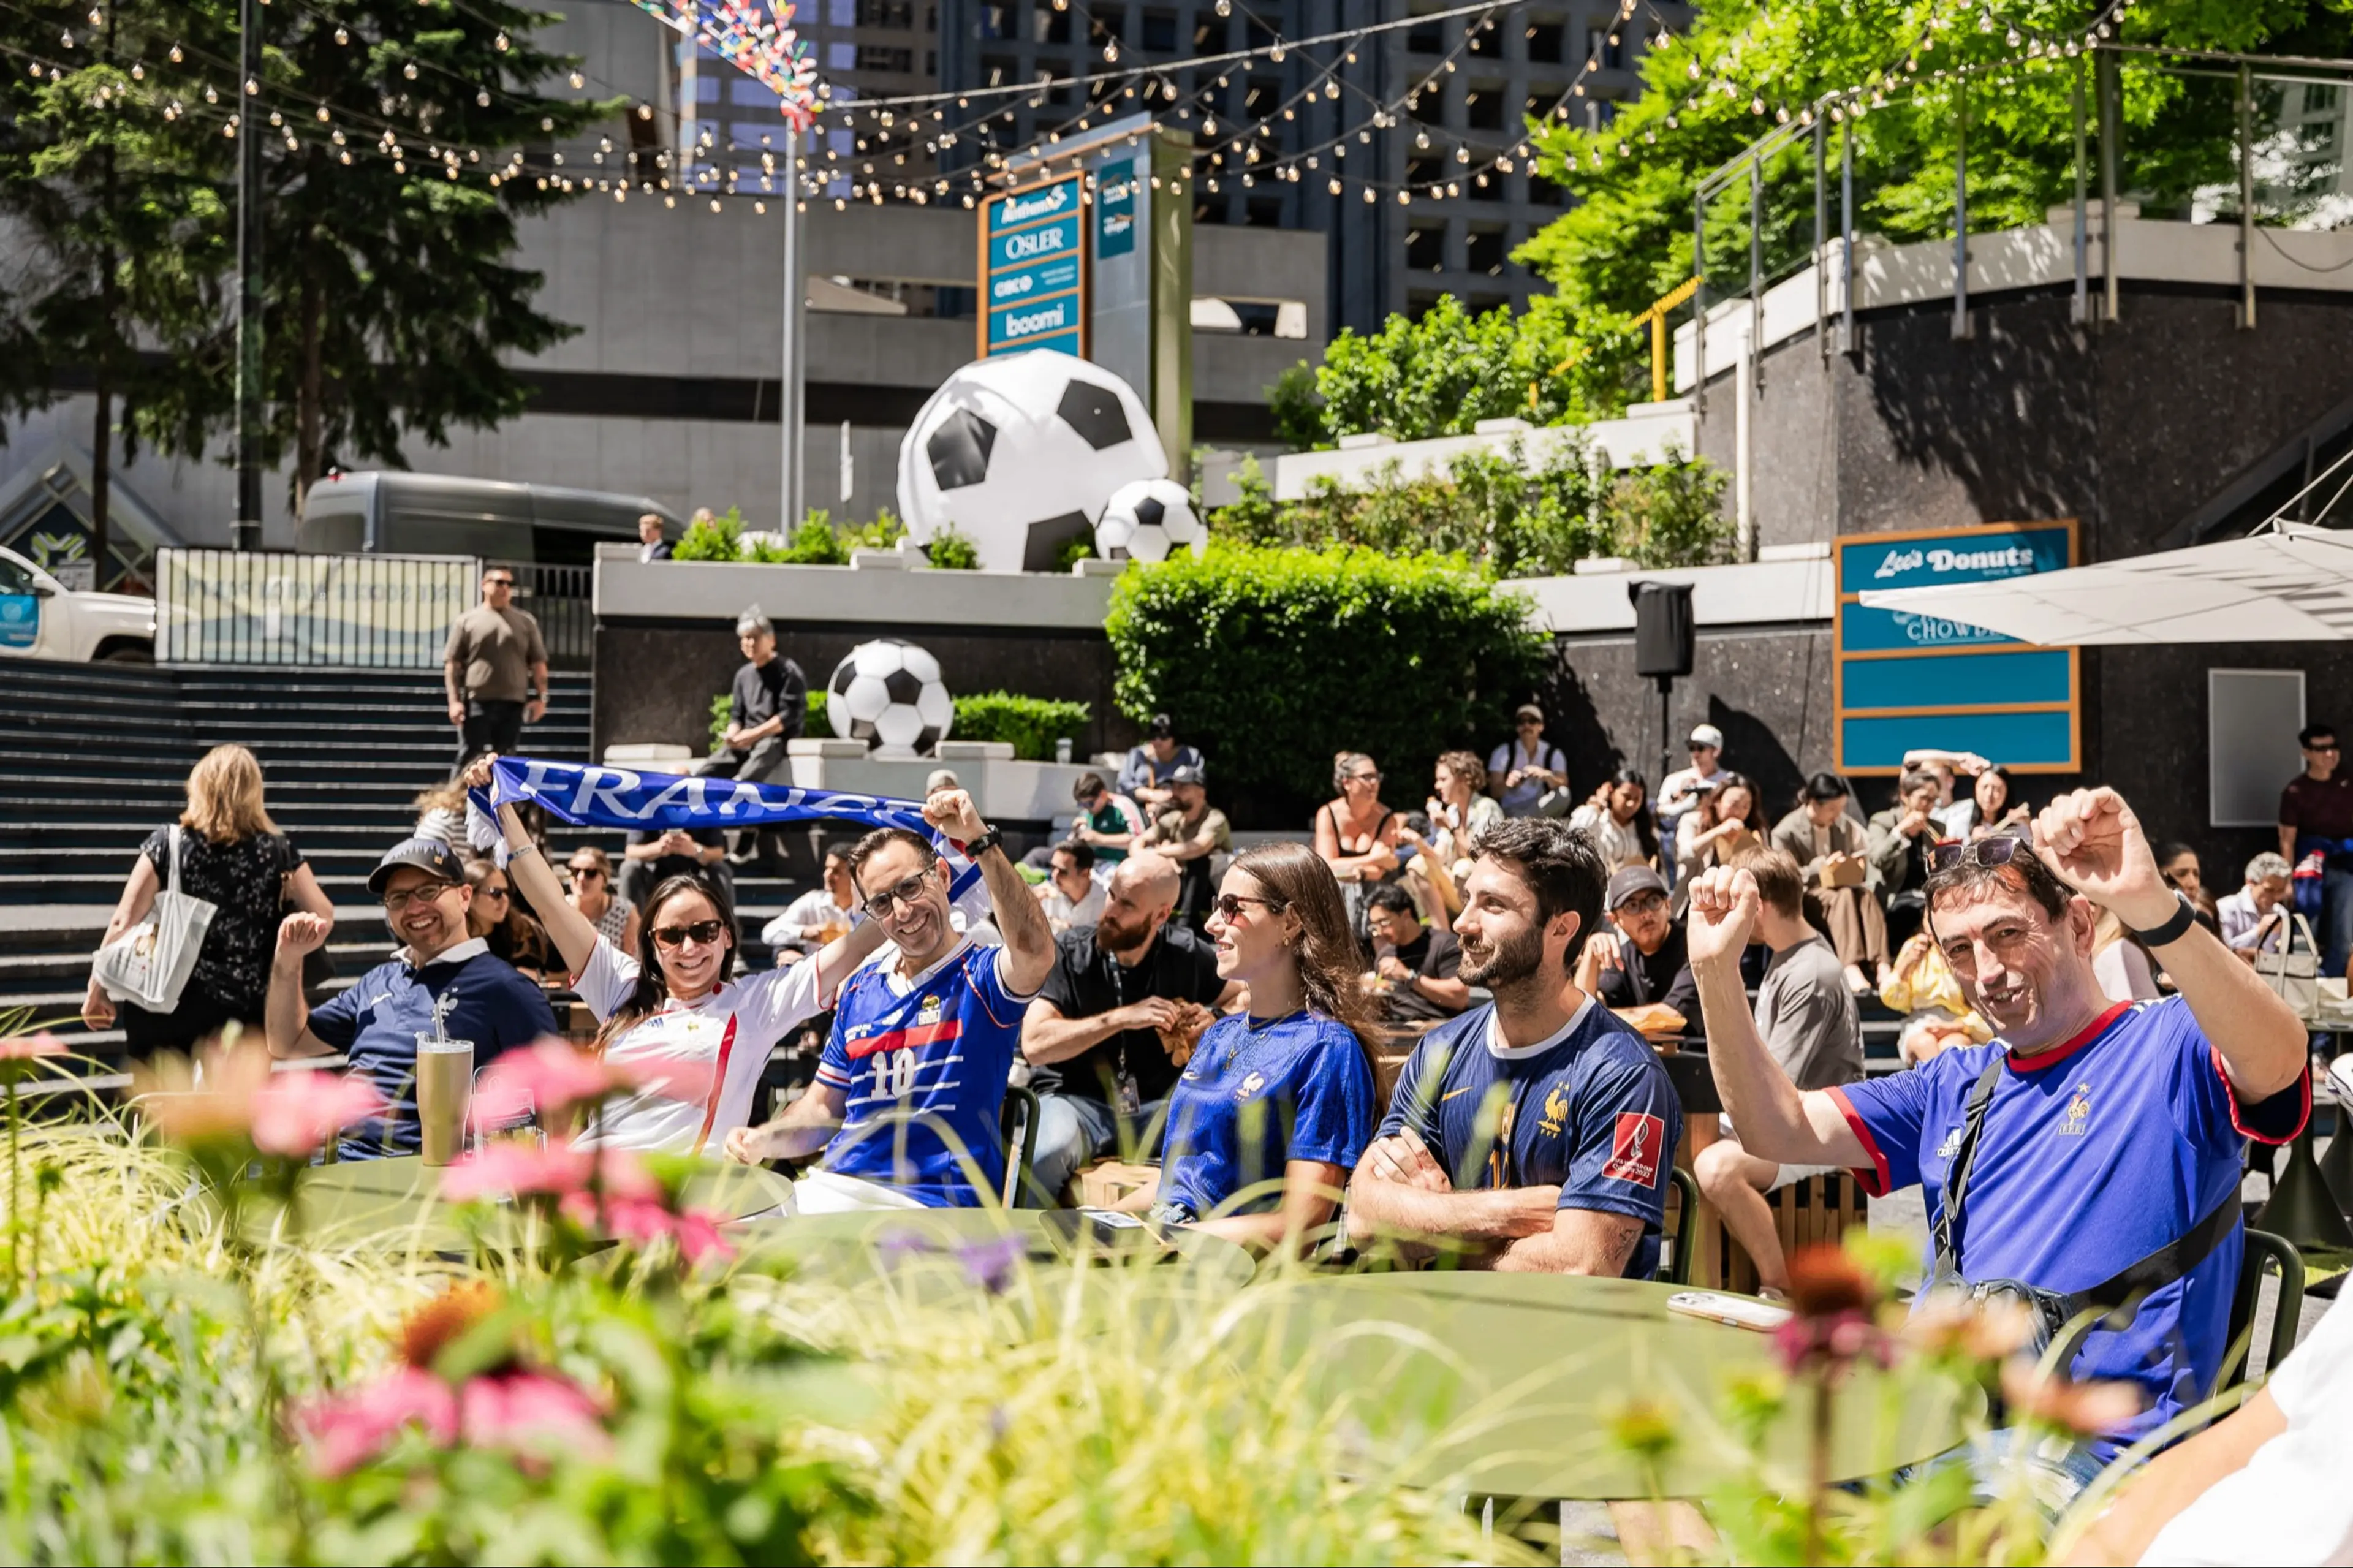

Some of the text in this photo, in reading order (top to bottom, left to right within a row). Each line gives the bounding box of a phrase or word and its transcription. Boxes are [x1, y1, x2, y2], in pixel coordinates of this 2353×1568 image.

[1006, 227, 1064, 260] OSLER
[1006, 303, 1064, 338] boomi
[1874, 546, 2033, 579] Lee's Donuts
[1907, 616, 2001, 640] CHOWD
[870, 1047, 915, 1100] 10
